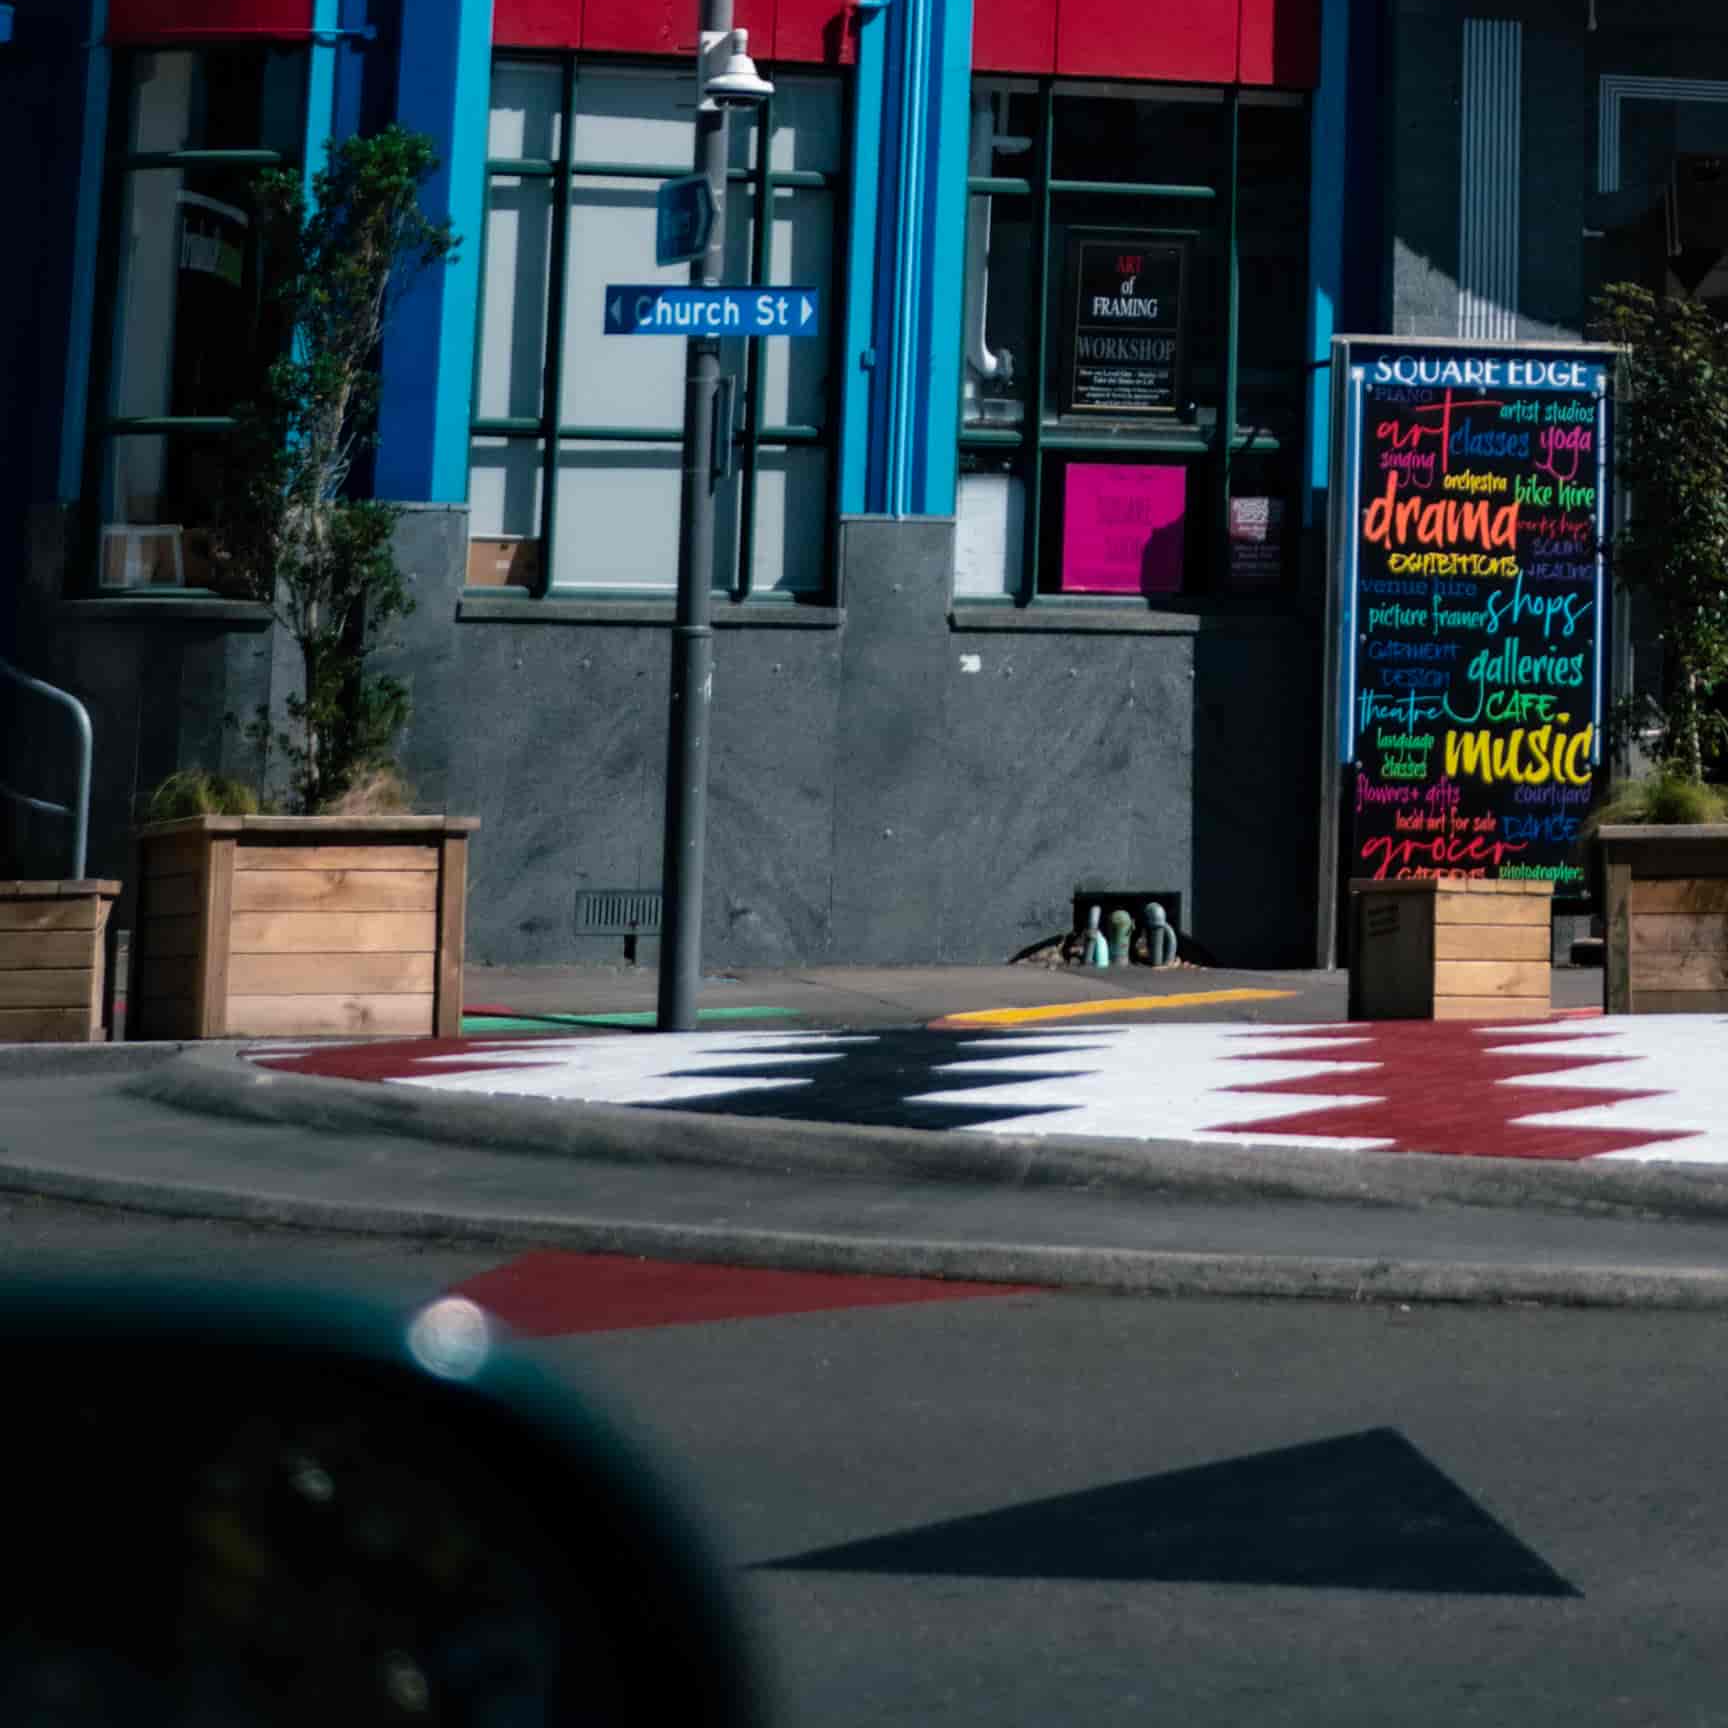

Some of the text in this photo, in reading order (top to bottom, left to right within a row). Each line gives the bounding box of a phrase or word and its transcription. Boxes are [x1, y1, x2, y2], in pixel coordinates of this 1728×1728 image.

[1120, 275, 1136, 295] of
[635, 295, 788, 326] Church St
[1092, 296, 1158, 319] FRAMING
[1078, 335, 1176, 361] WORKSHOP
[1375, 353, 1587, 387] SQUARE EDGE
[1376, 386, 1503, 473] art
[1500, 400, 1594, 424] artist studios
[1450, 415, 1530, 458] classes
[1535, 425, 1592, 480] yoga
[1379, 449, 1436, 488] singing
[1443, 469, 1508, 495] orchestra
[1363, 469, 1519, 551] drama
[1514, 474, 1595, 512] bike hire
[1388, 551, 1519, 578] EXHIBITIONS
[1368, 593, 1488, 635] picture framer
[1487, 567, 1592, 637] shops
[1357, 688, 1443, 733] theatre
[1486, 690, 1557, 723] CAFE
[1445, 712, 1592, 785] music
[1450, 806, 1469, 839] for
[1360, 834, 1528, 881] grocer
